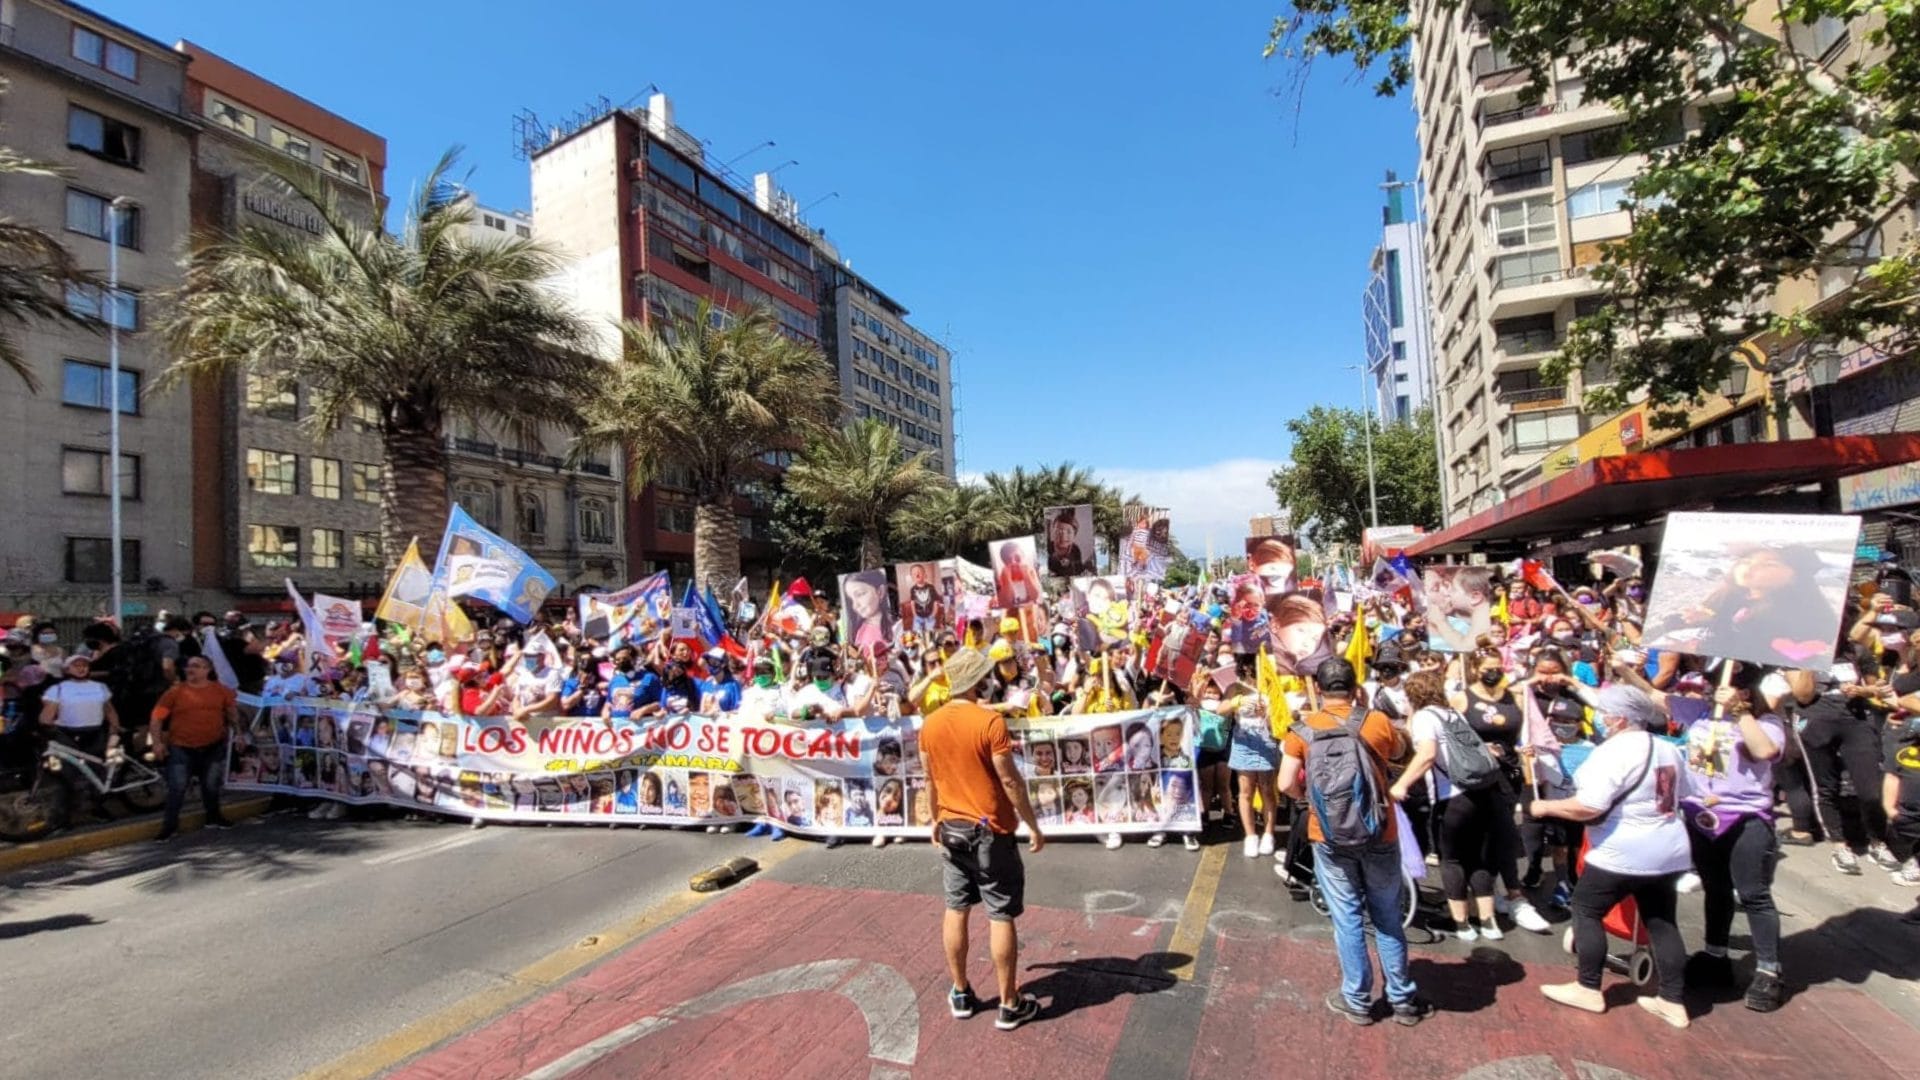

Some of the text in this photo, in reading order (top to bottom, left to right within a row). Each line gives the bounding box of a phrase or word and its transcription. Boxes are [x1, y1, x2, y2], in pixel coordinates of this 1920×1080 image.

[465, 723, 860, 759] LOS NIÑOS NO SE TOCAN
